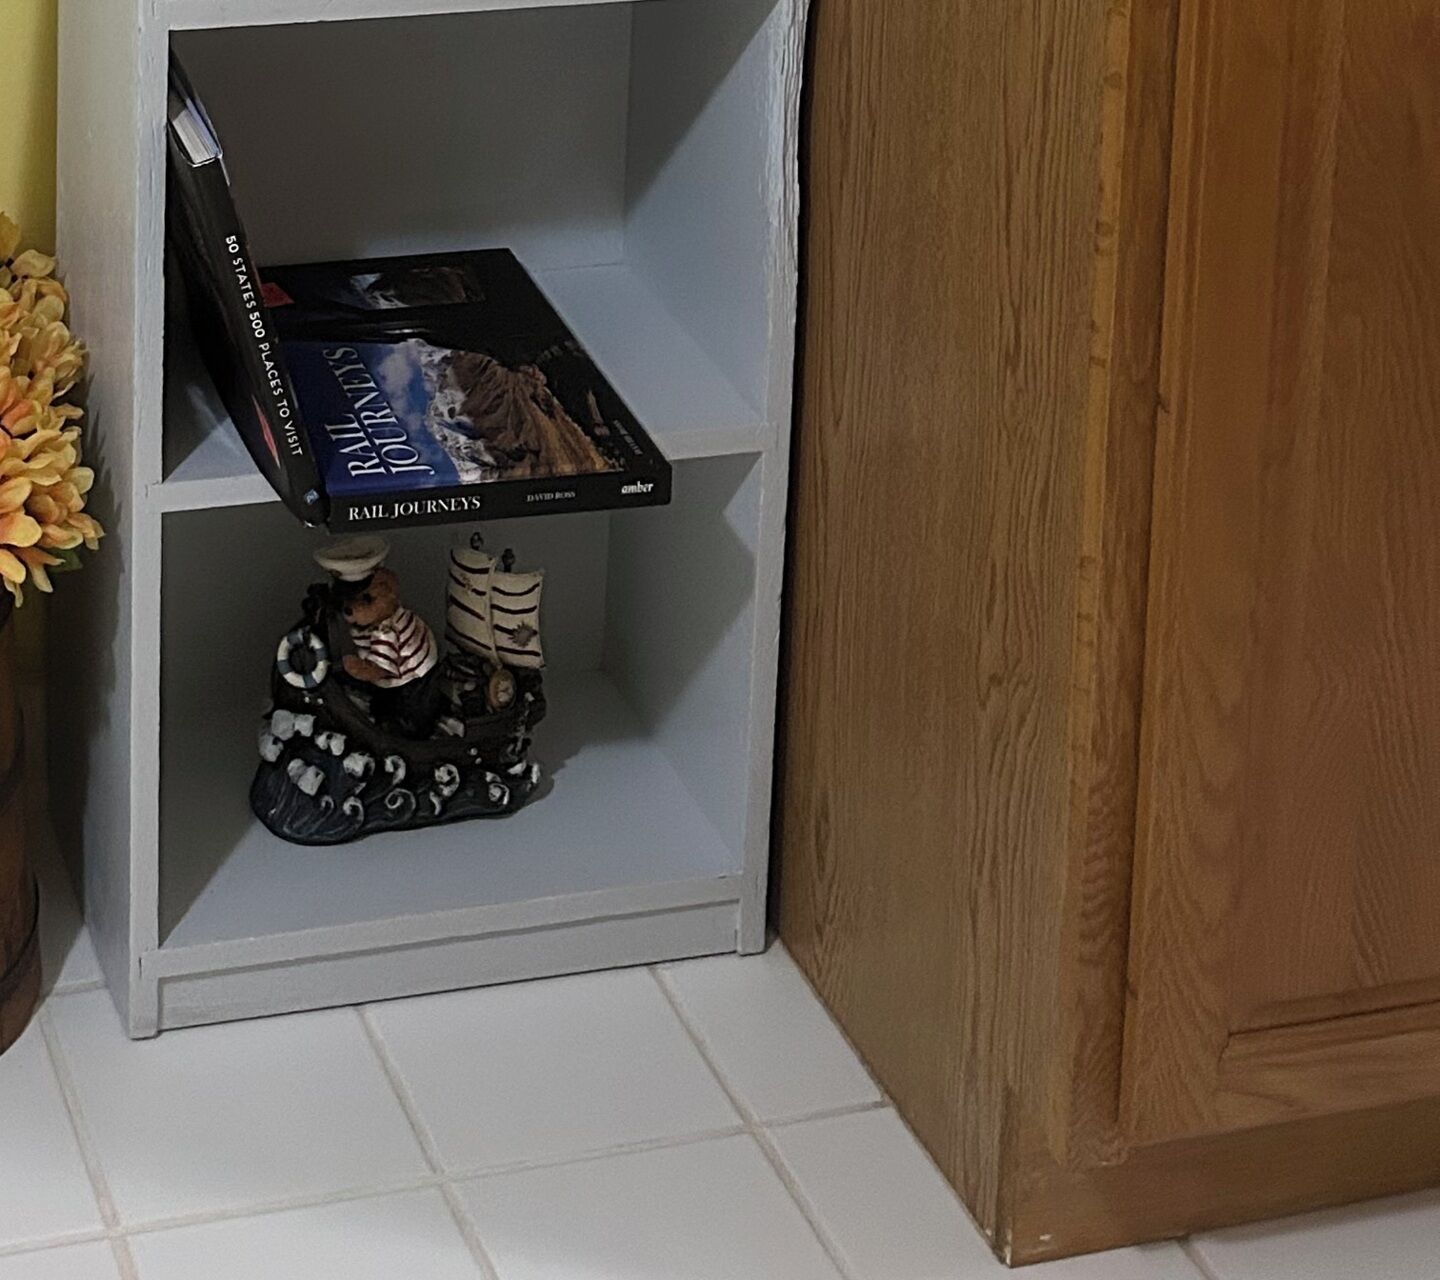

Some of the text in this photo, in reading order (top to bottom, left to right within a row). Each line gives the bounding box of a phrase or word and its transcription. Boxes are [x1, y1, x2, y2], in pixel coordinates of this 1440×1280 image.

[225, 235, 303, 456] 50 STATES 500 PLACES TO VISIT
[322, 346, 436, 476] JOURNEYS
[324, 412, 388, 477] RAIL
[348, 505, 388, 521] RAIL
[390, 495, 482, 519] JOURNEYS
[526, 492, 554, 502] DAVID
[620, 480, 654, 495] amber
